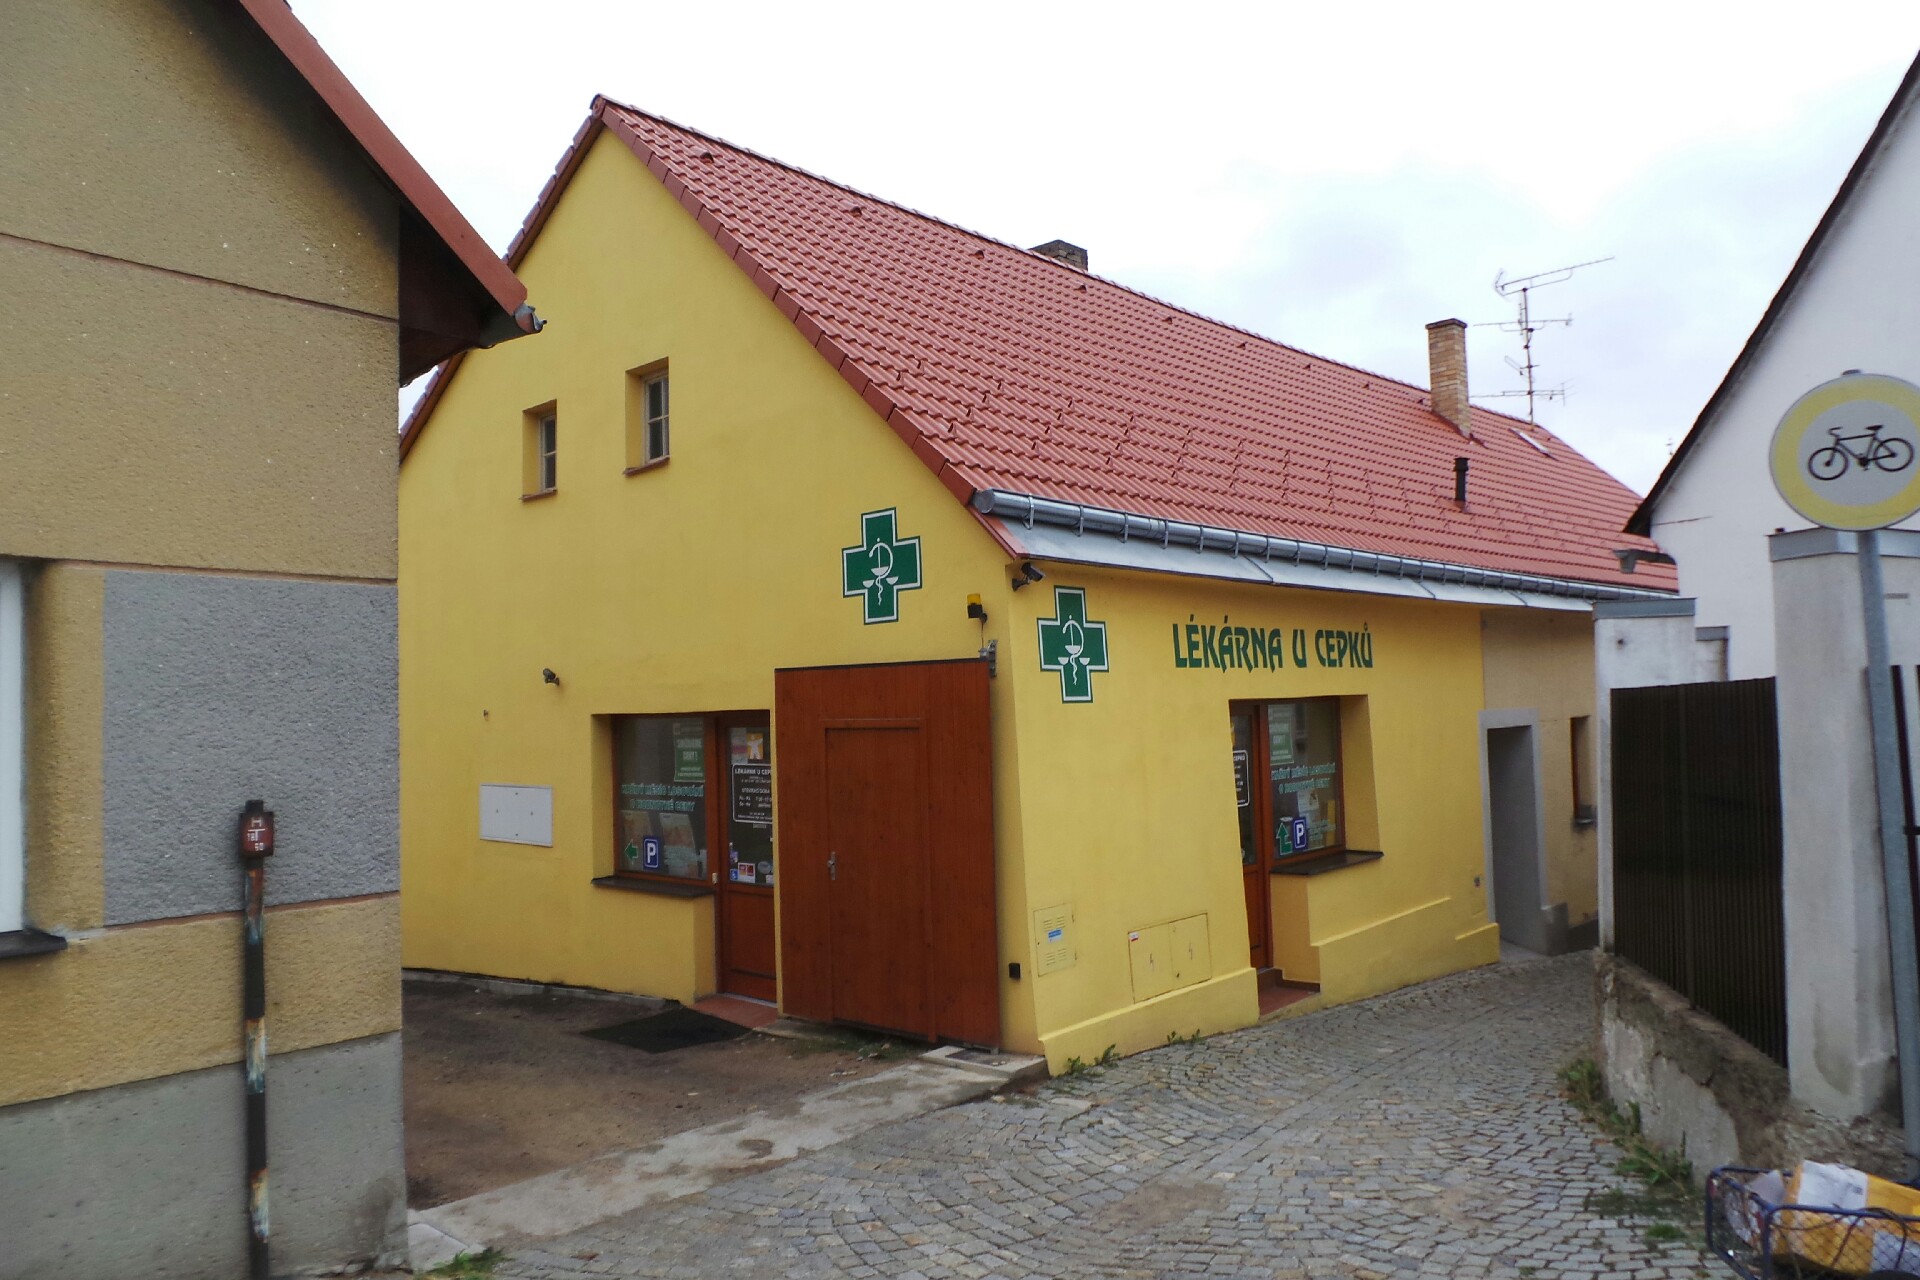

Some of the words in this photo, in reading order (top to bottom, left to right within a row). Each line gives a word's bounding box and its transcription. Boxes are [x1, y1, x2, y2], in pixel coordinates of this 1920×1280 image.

[1172, 613, 1284, 674] LÉKÁRNA
[1292, 628, 1308, 668] U
[1314, 621, 1374, 668] CEPKŮ
[1296, 823, 1304, 845] P
[647, 842, 656, 864] P
